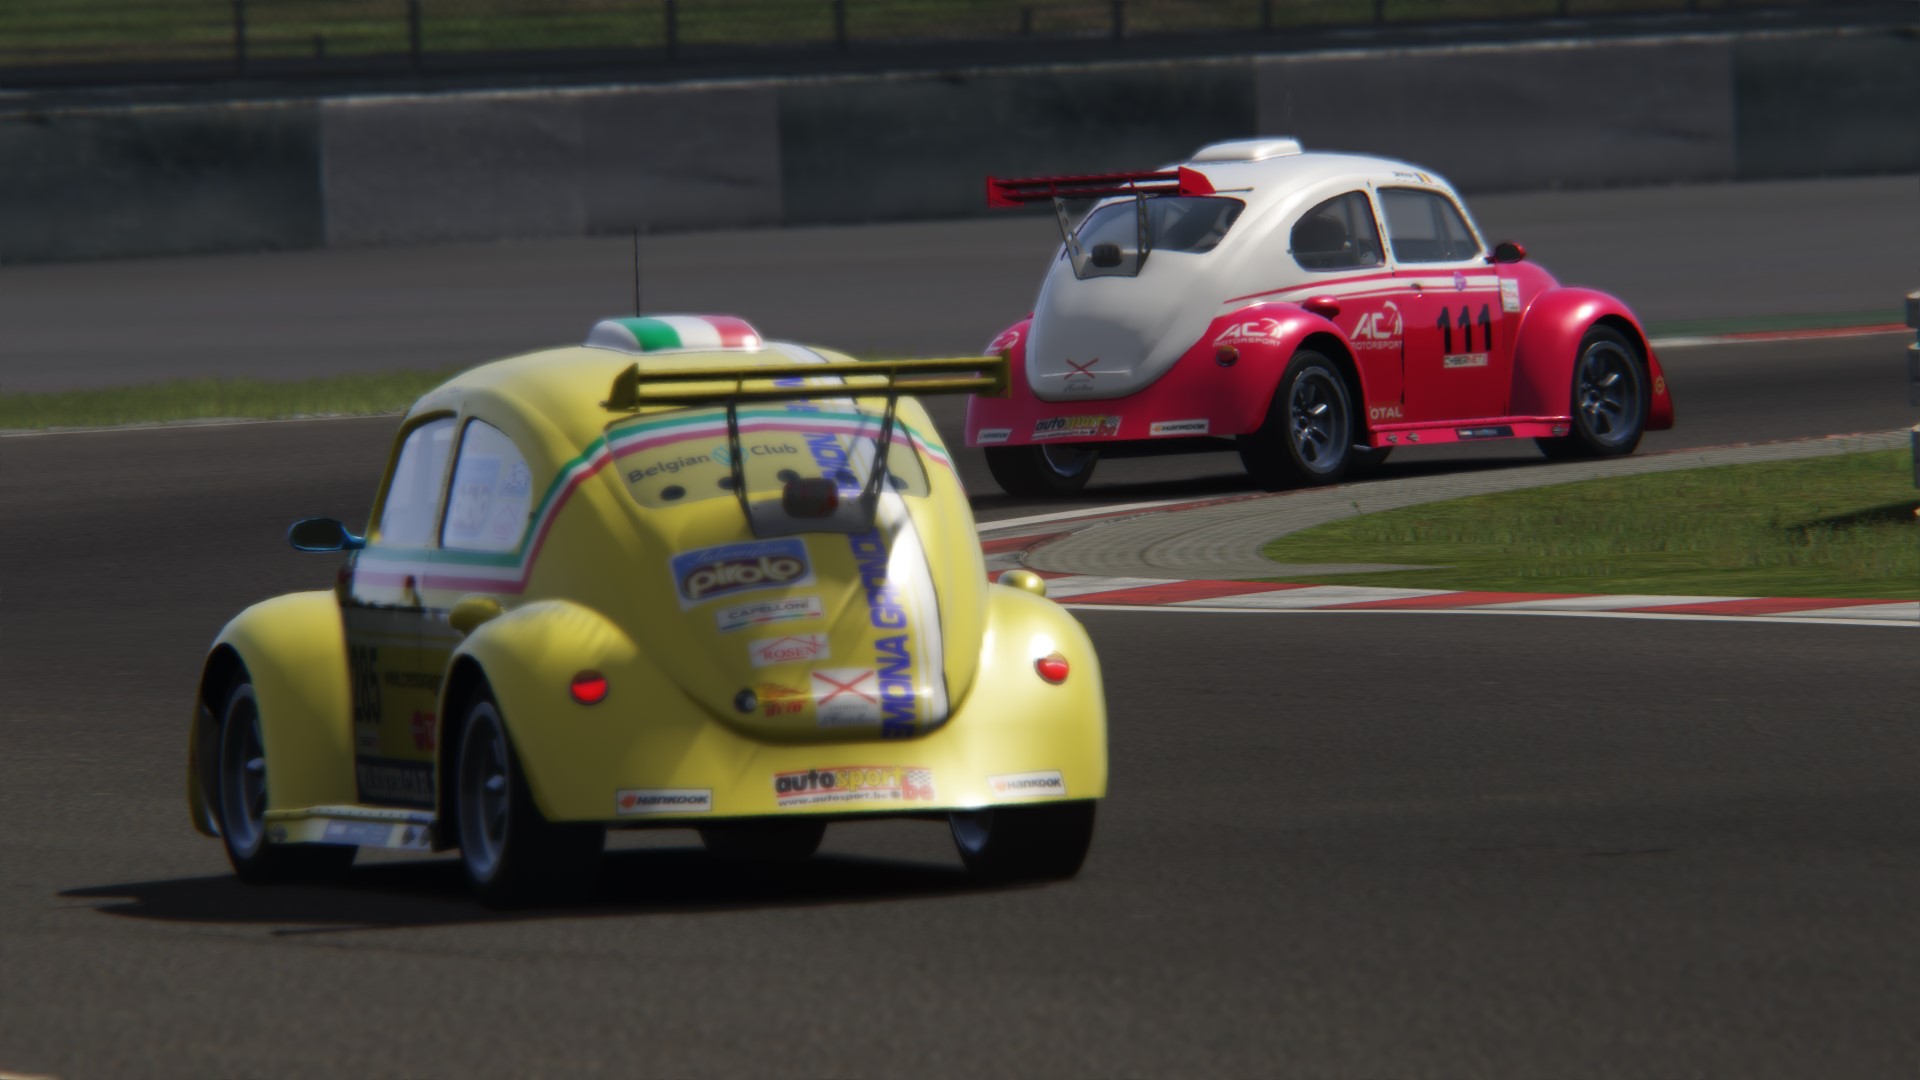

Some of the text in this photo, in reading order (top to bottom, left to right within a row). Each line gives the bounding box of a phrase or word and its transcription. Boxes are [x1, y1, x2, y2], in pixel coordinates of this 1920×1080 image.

[1436, 303, 1492, 353] 111
[1369, 406, 1403, 420] OTAL
[628, 455, 709, 483] Belgian
[750, 443, 798, 458] Club
[687, 556, 802, 600] pirolo
[775, 769, 905, 792] autosport
